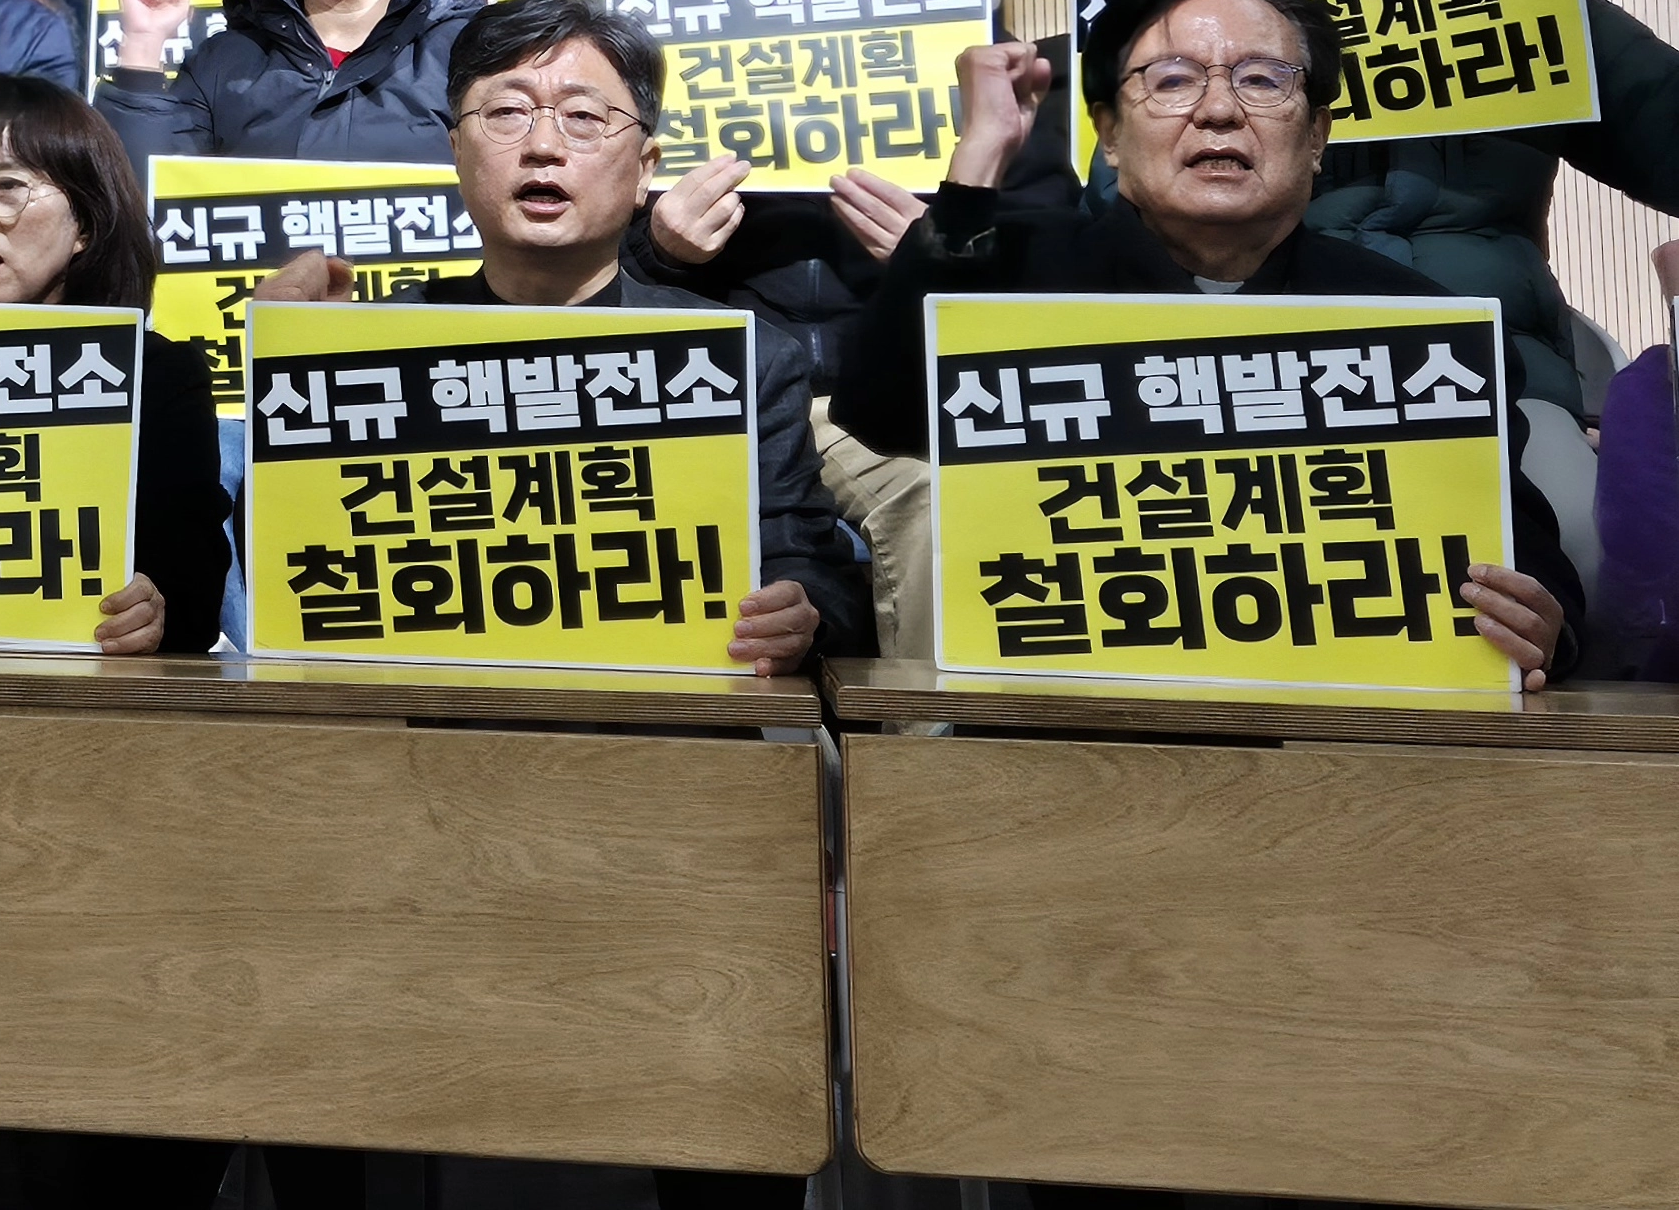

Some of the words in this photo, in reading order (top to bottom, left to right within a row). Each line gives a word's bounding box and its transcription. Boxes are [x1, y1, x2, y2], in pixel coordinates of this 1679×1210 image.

[679, 30, 918, 101] 건설계획
[156, 205, 266, 264] 신규
[256, 366, 408, 446] 신규
[429, 346, 742, 434] 핵발전소
[943, 362, 1112, 449] 신규
[1134, 342, 1492, 435] 핵발전소
[339, 445, 656, 538] 건설계획
[1037, 447, 1397, 545] 건설계획
[286, 524, 728, 642] 철회하라!
[979, 534, 1482, 659] 철회하라!
